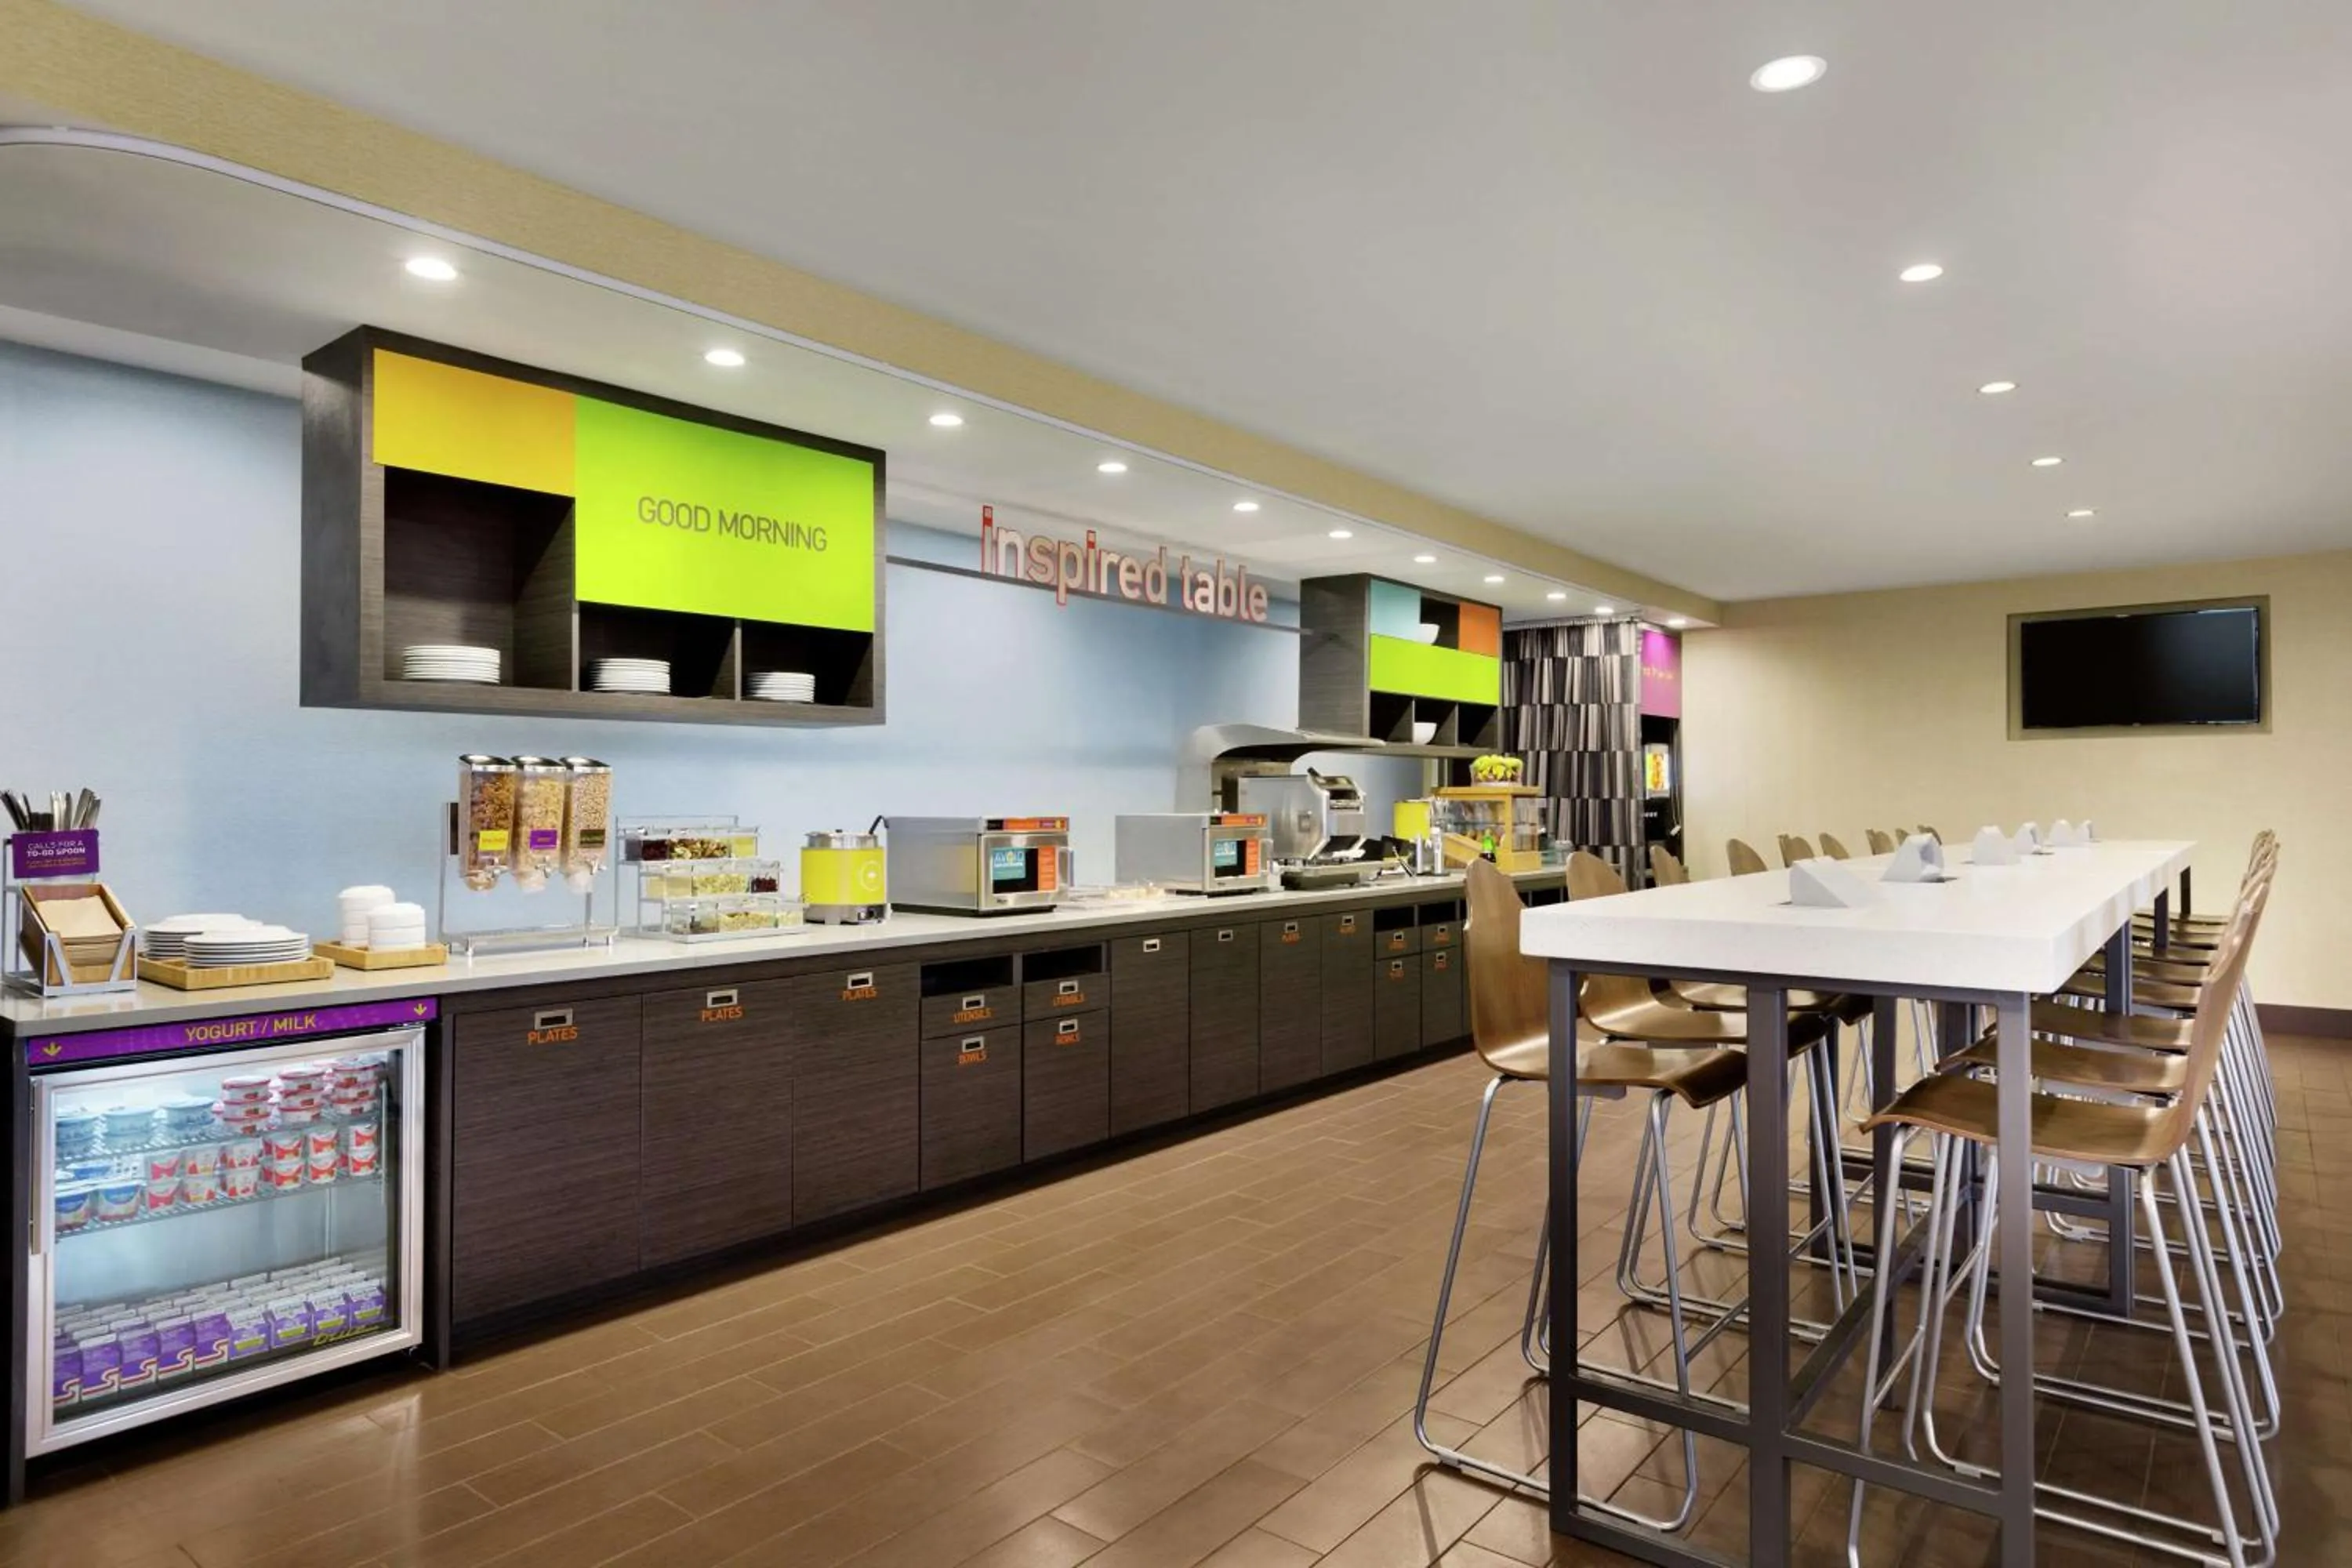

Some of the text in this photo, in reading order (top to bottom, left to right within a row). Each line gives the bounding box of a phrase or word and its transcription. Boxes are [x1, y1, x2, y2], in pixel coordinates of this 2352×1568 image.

[637, 495, 828, 553] GOOD MORNING
[981, 504, 1269, 623] inspired table
[56, 847, 86, 856] SPOON
[843, 987, 877, 1001] PLATES
[701, 1005, 744, 1022] PLATES
[184, 1014, 318, 1042] YOGURT / MILK
[526, 1025, 579, 1047] PLATES
